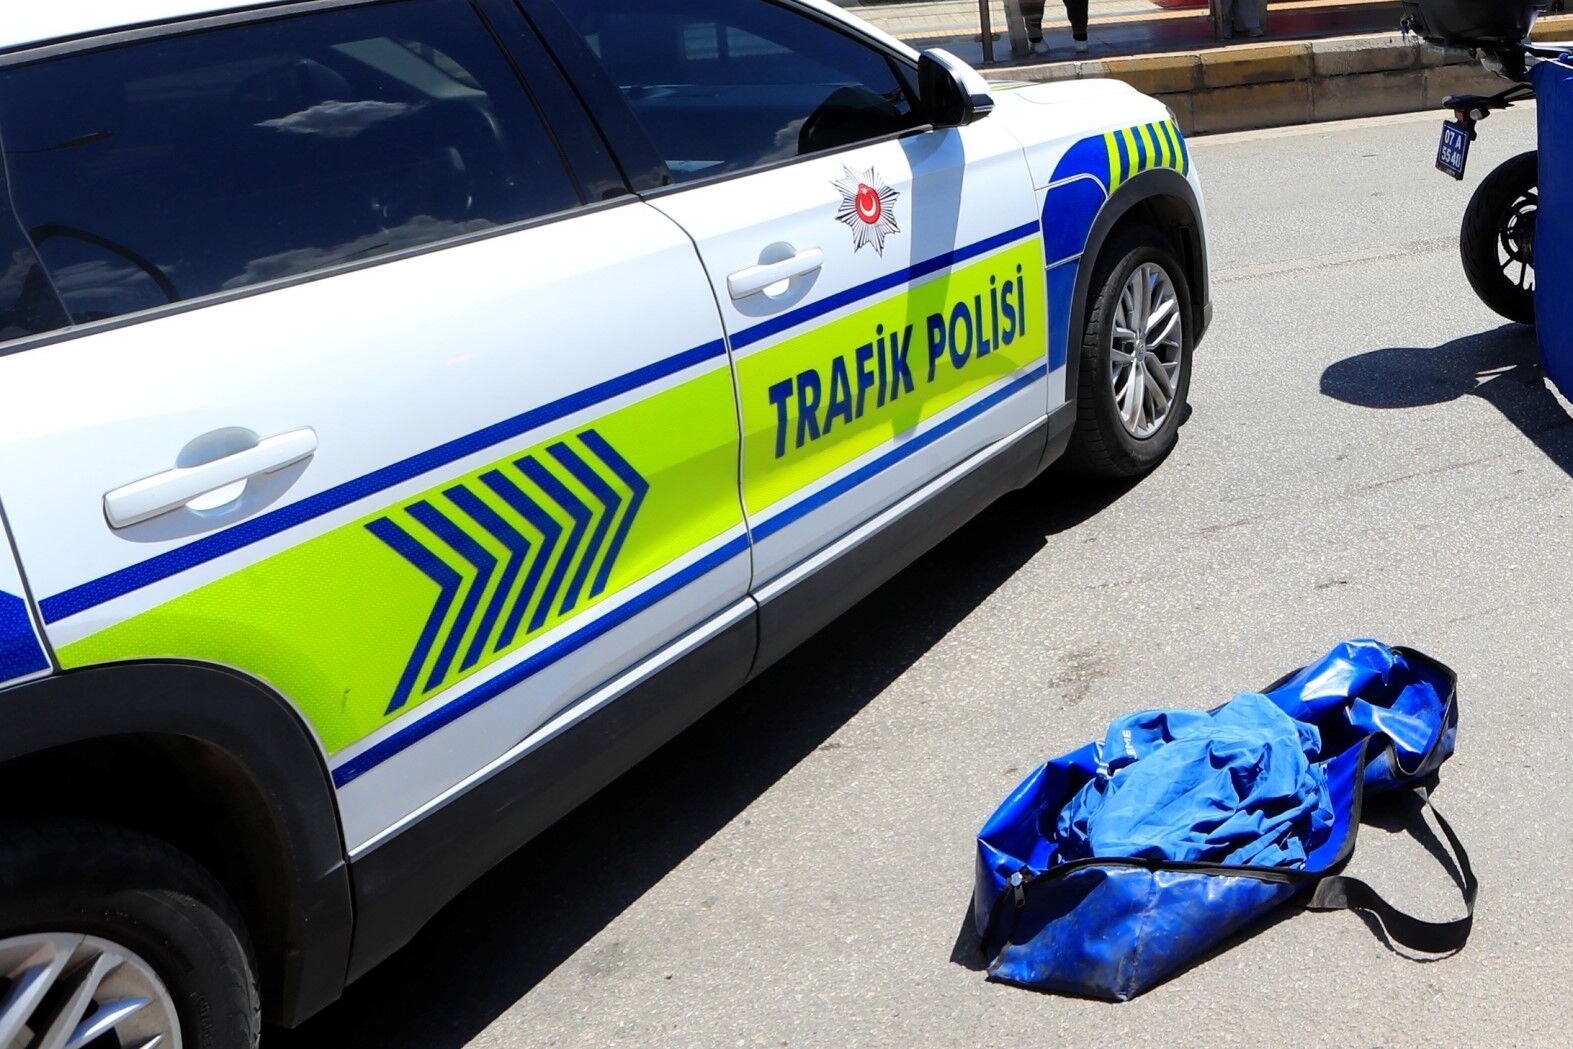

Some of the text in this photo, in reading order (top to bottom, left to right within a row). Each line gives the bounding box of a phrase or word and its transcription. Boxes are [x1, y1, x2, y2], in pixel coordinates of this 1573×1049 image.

[1444, 129, 1462, 150] 07 A
[768, 263, 1026, 459] TRAFİK POLİSİ
